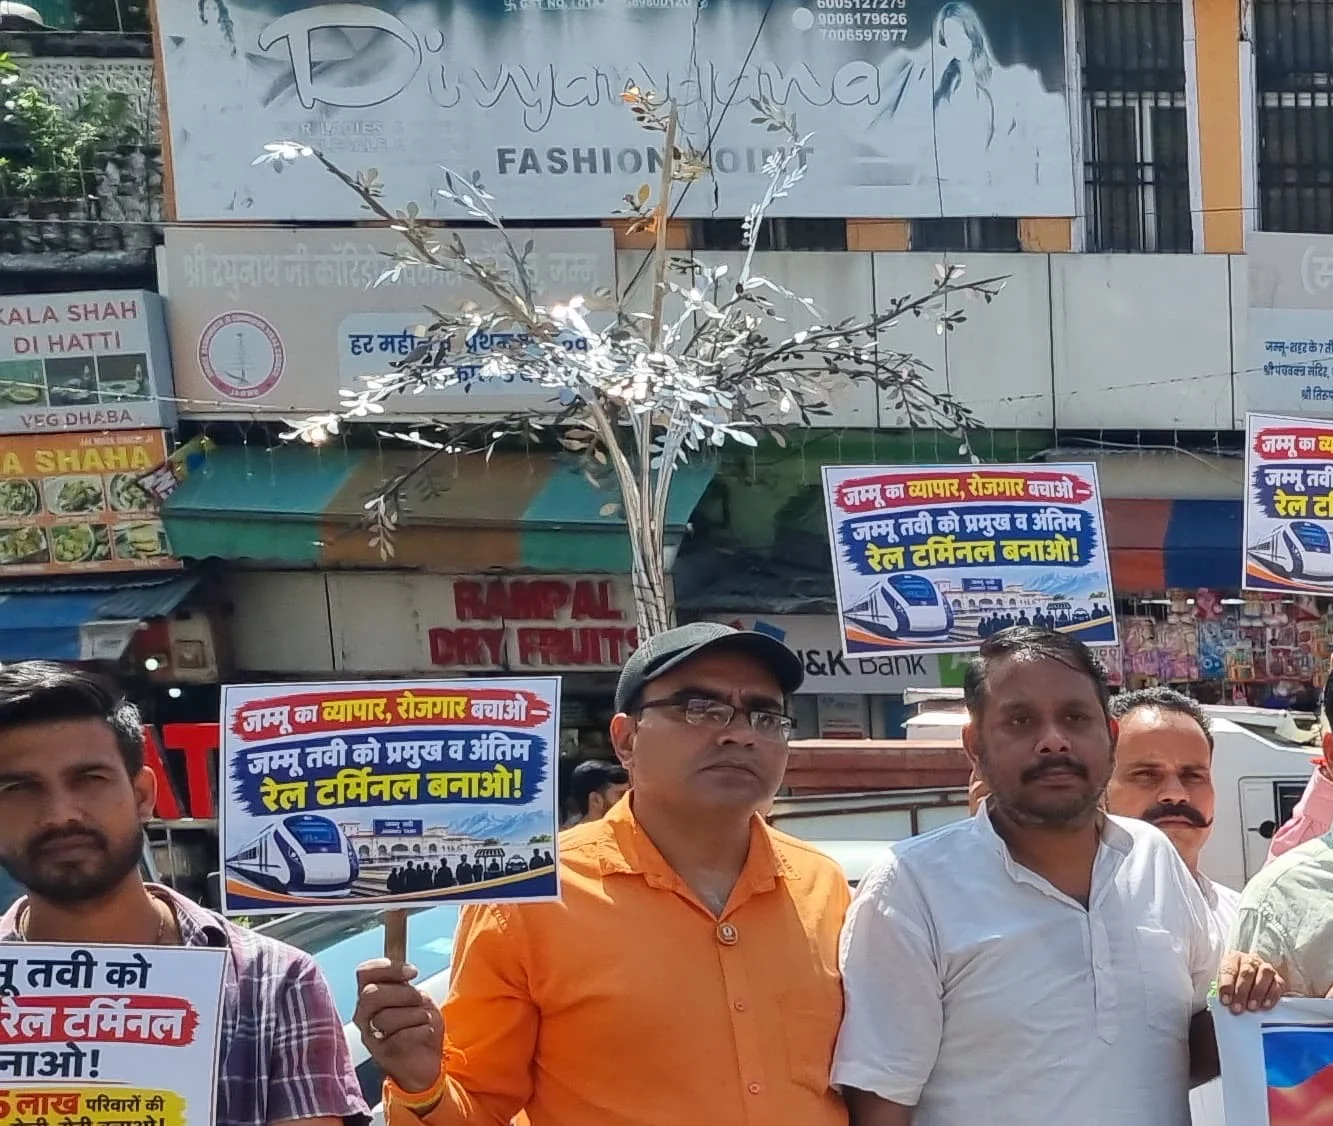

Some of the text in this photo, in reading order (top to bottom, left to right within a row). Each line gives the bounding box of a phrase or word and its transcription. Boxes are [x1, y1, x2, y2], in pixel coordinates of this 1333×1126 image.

[497, 146, 667, 175] FASHION
[67, 300, 137, 322] SHAH
[14, 330, 122, 354] DI HATTI
[349, 333, 375, 358] हर
[20, 409, 133, 428] VEG DHABA
[454, 580, 625, 620] RAMPAL
[428, 627, 504, 665] DRY
[860, 654, 927, 676] Bank
[243, 691, 528, 734] जम्मू का व्यापार, रोजगार बचाओ
[248, 731, 532, 777] जम्मू तवी को प्रमुख व अंतिम
[260, 763, 523, 812] रेल टर्मिनल बनाओ!
